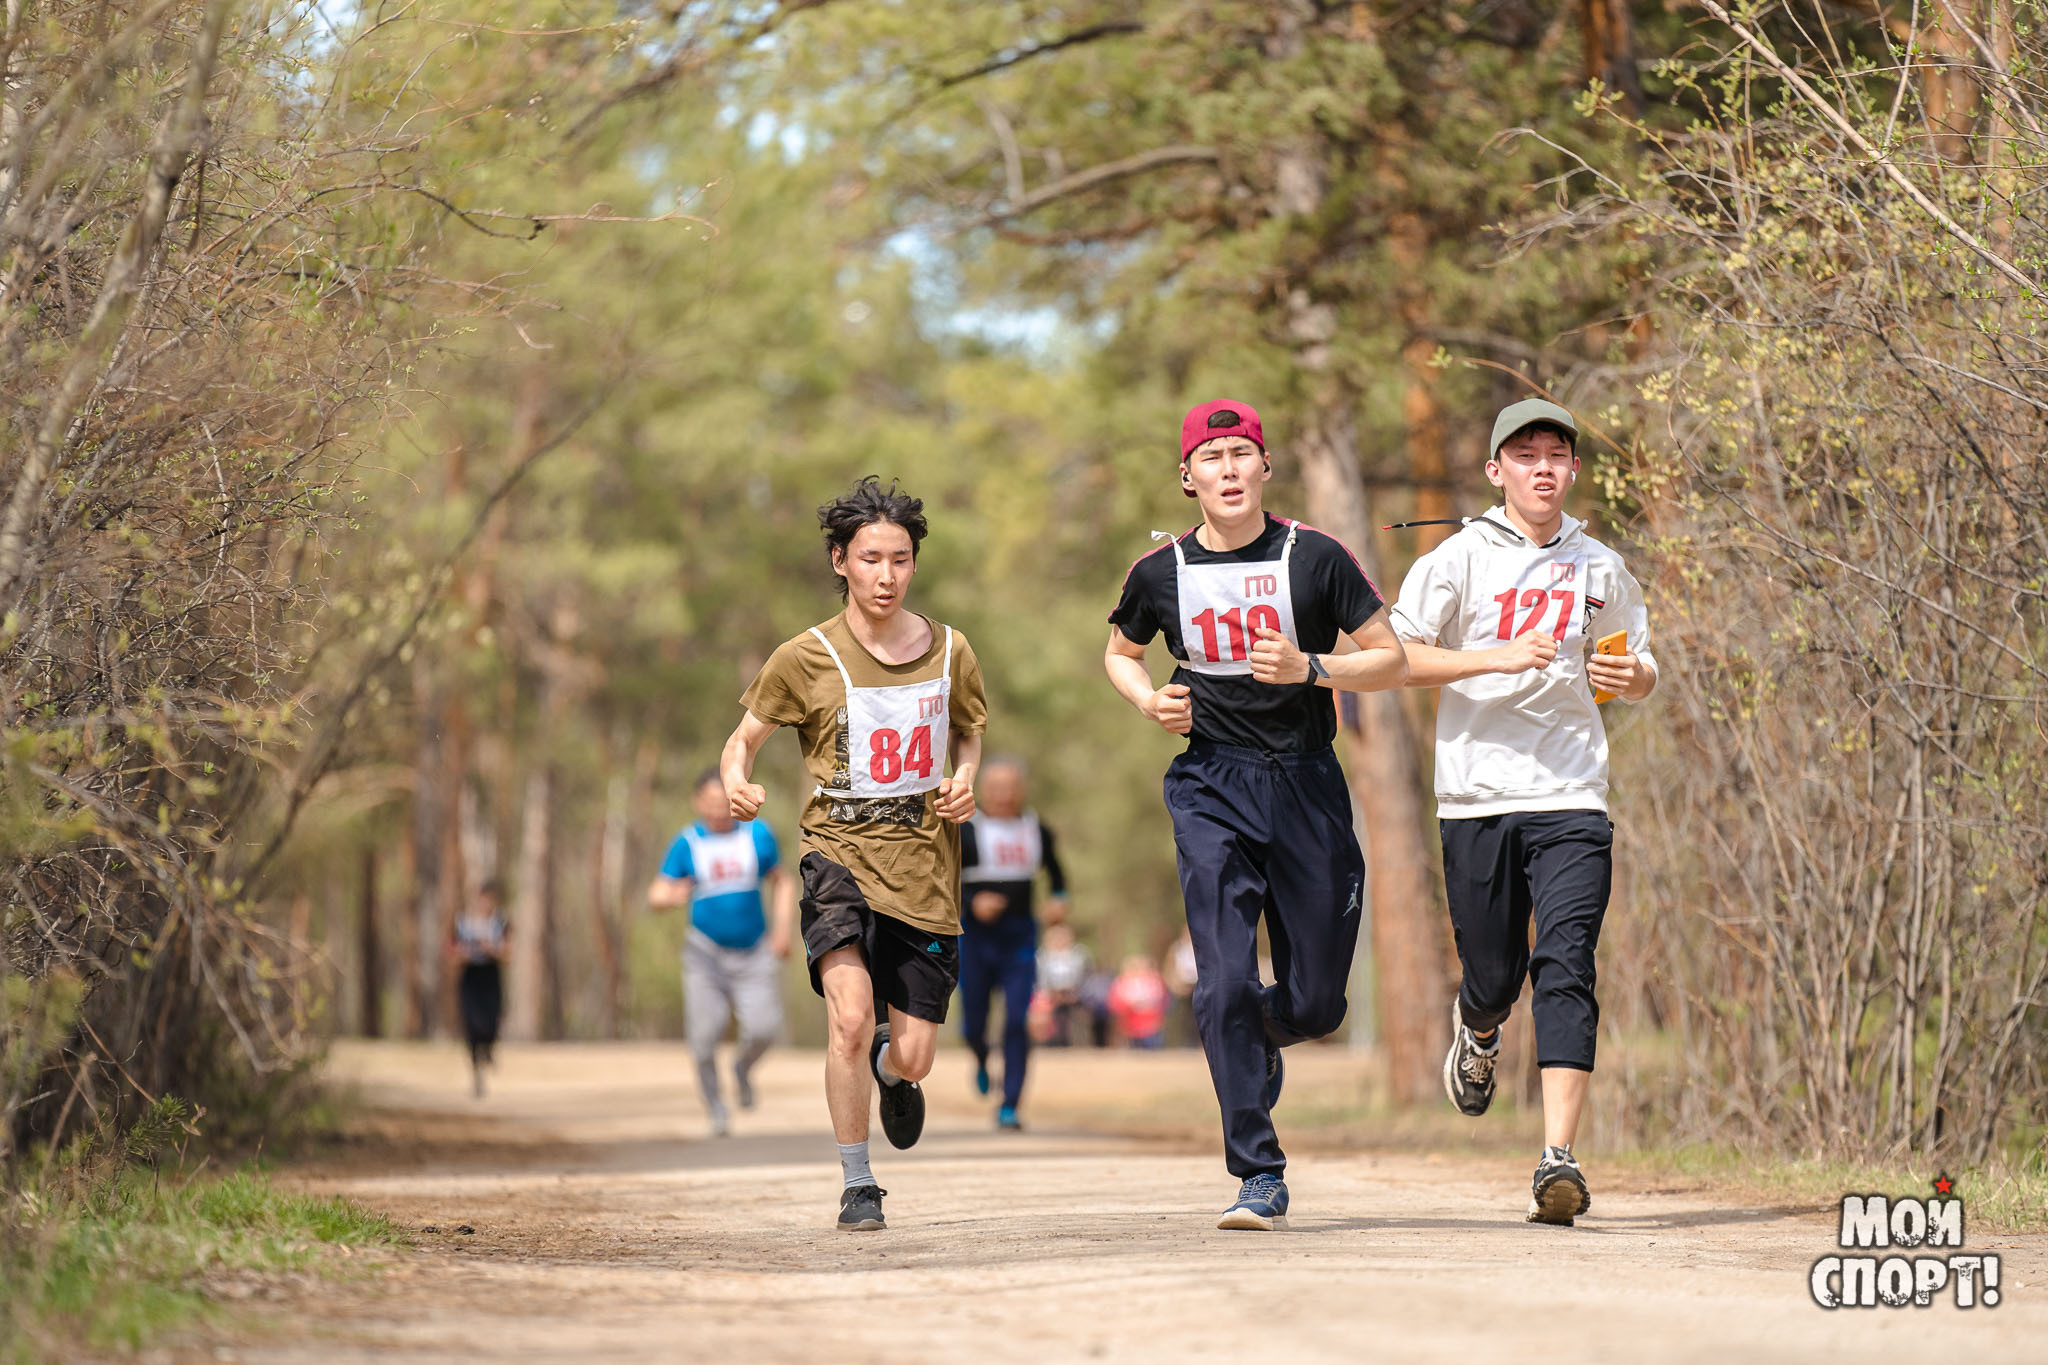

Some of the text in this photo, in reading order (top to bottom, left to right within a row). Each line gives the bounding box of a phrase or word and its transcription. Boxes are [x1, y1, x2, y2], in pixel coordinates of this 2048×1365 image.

[1244, 574, 1277, 598] ГТО
[1494, 587, 1575, 641] 127
[918, 694, 944, 719] ГТО
[870, 725, 934, 784] 84
